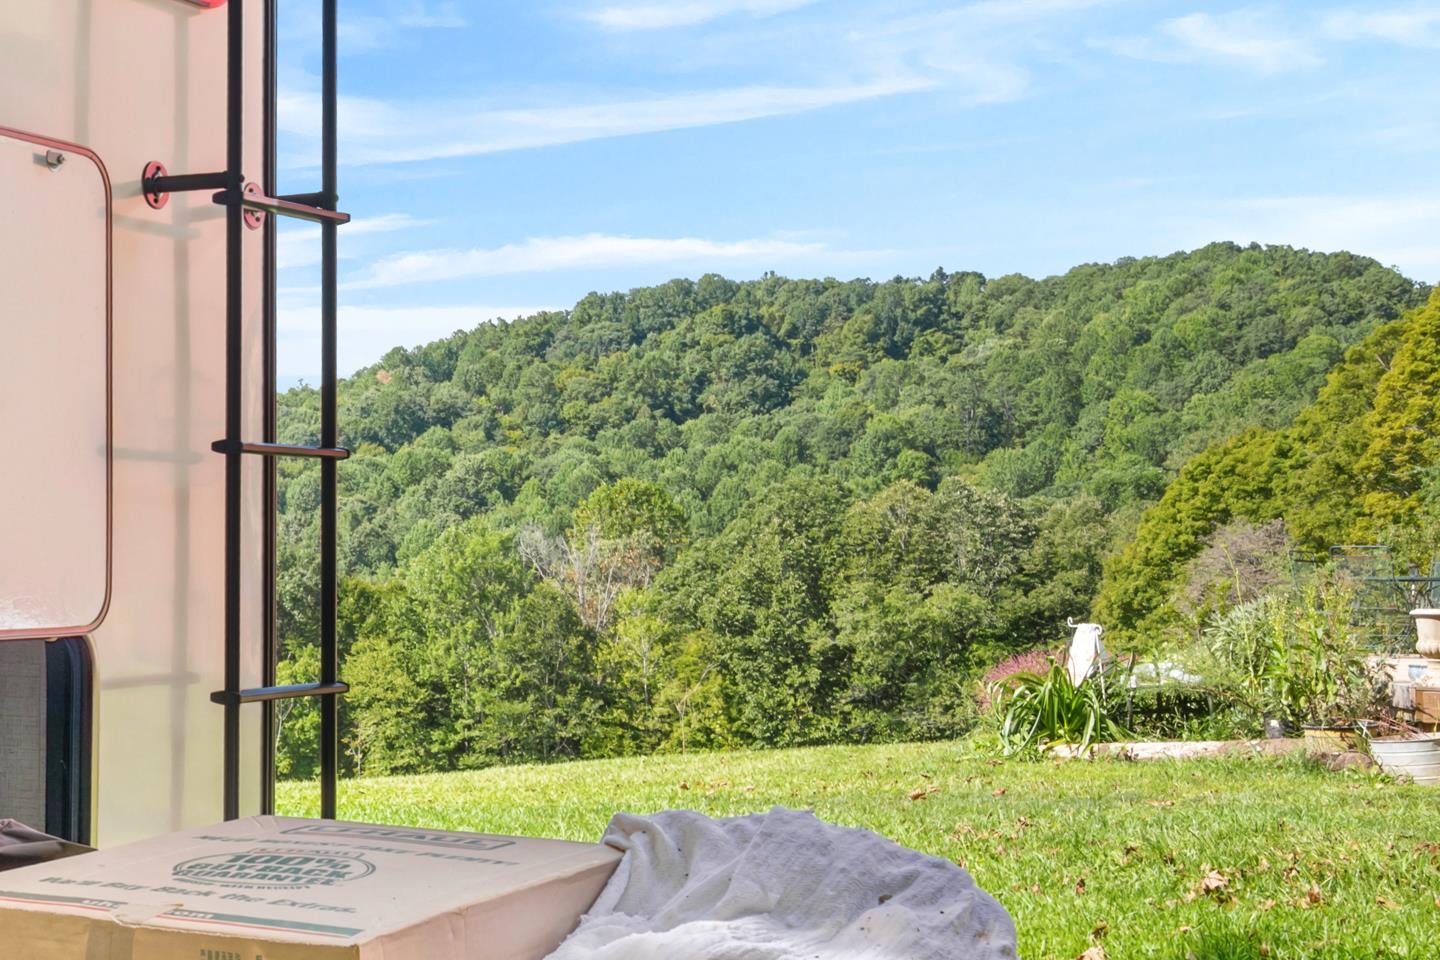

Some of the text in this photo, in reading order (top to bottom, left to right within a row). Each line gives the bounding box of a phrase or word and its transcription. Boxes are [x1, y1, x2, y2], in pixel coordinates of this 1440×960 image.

[224, 854, 352, 871] 100%
[172, 869, 337, 887] GUARANTEE
[151, 885, 220, 898] Back
